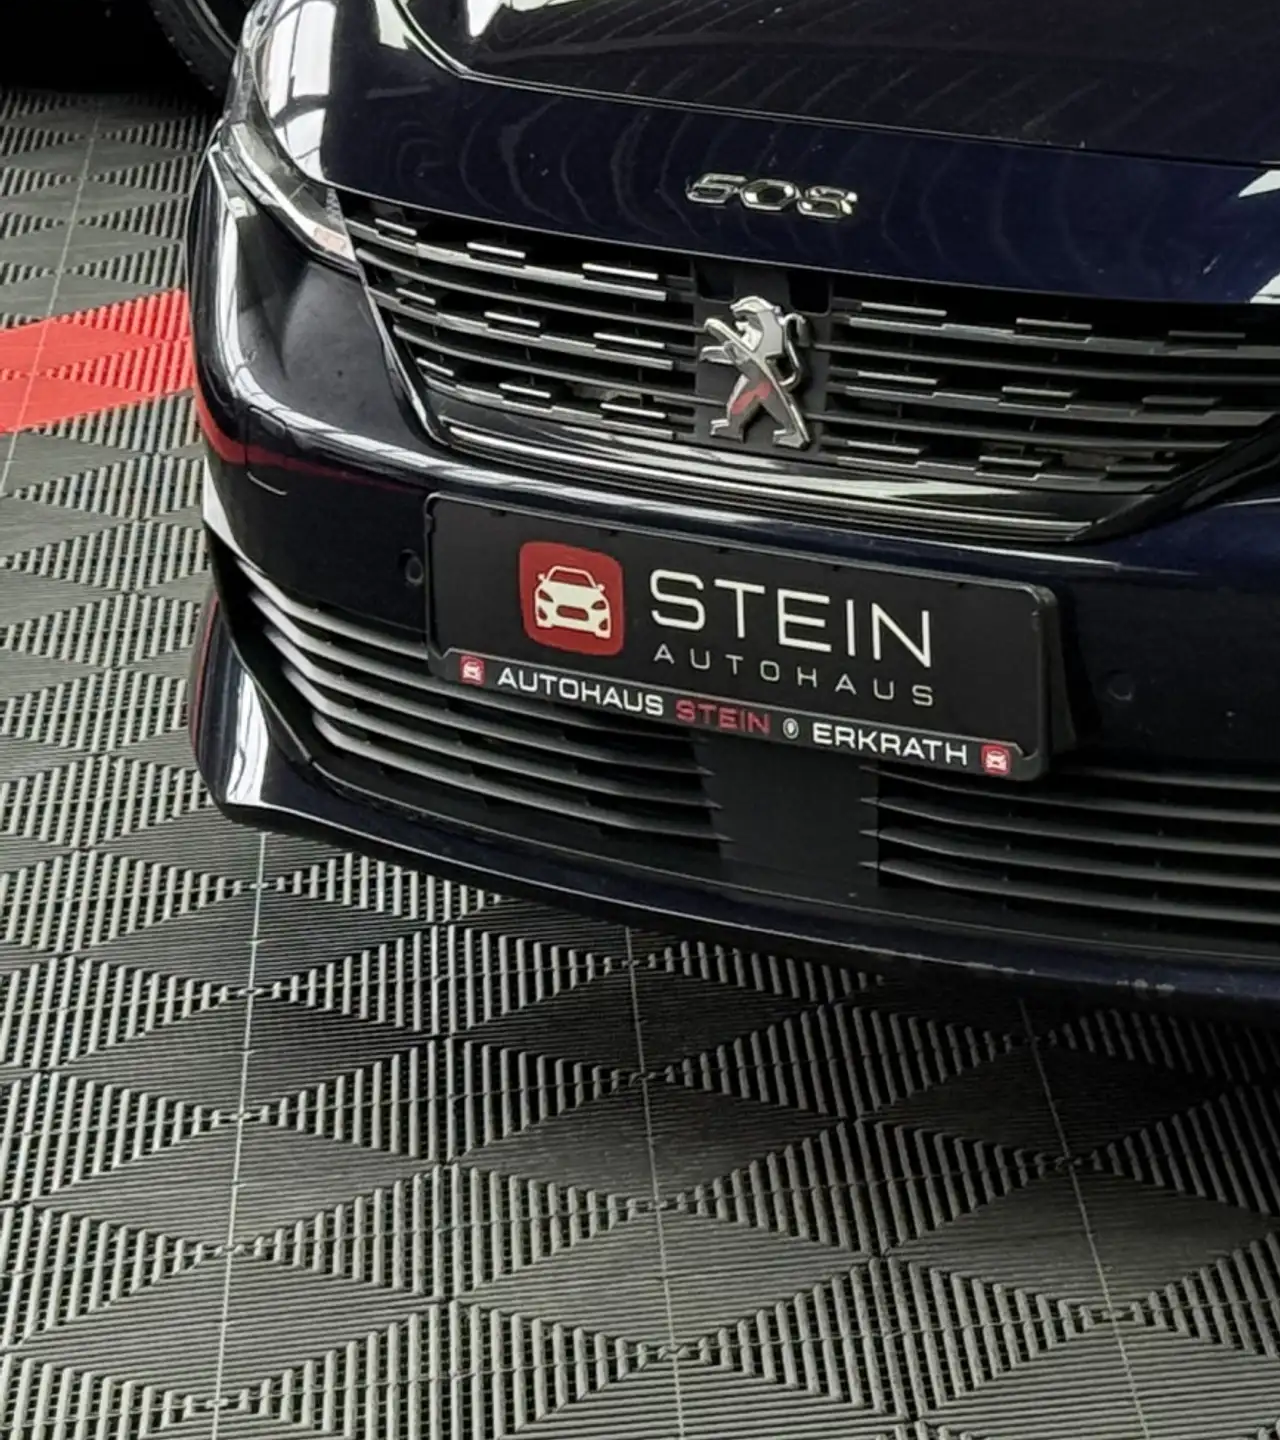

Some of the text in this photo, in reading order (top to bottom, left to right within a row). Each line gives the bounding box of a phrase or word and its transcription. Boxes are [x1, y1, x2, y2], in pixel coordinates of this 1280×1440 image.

[685, 172, 858, 220] 508
[649, 567, 932, 668] STEIN
[653, 643, 934, 708] AUTOHAUS
[497, 669, 968, 767] AUTOHAUS STEIN ERKRATH
